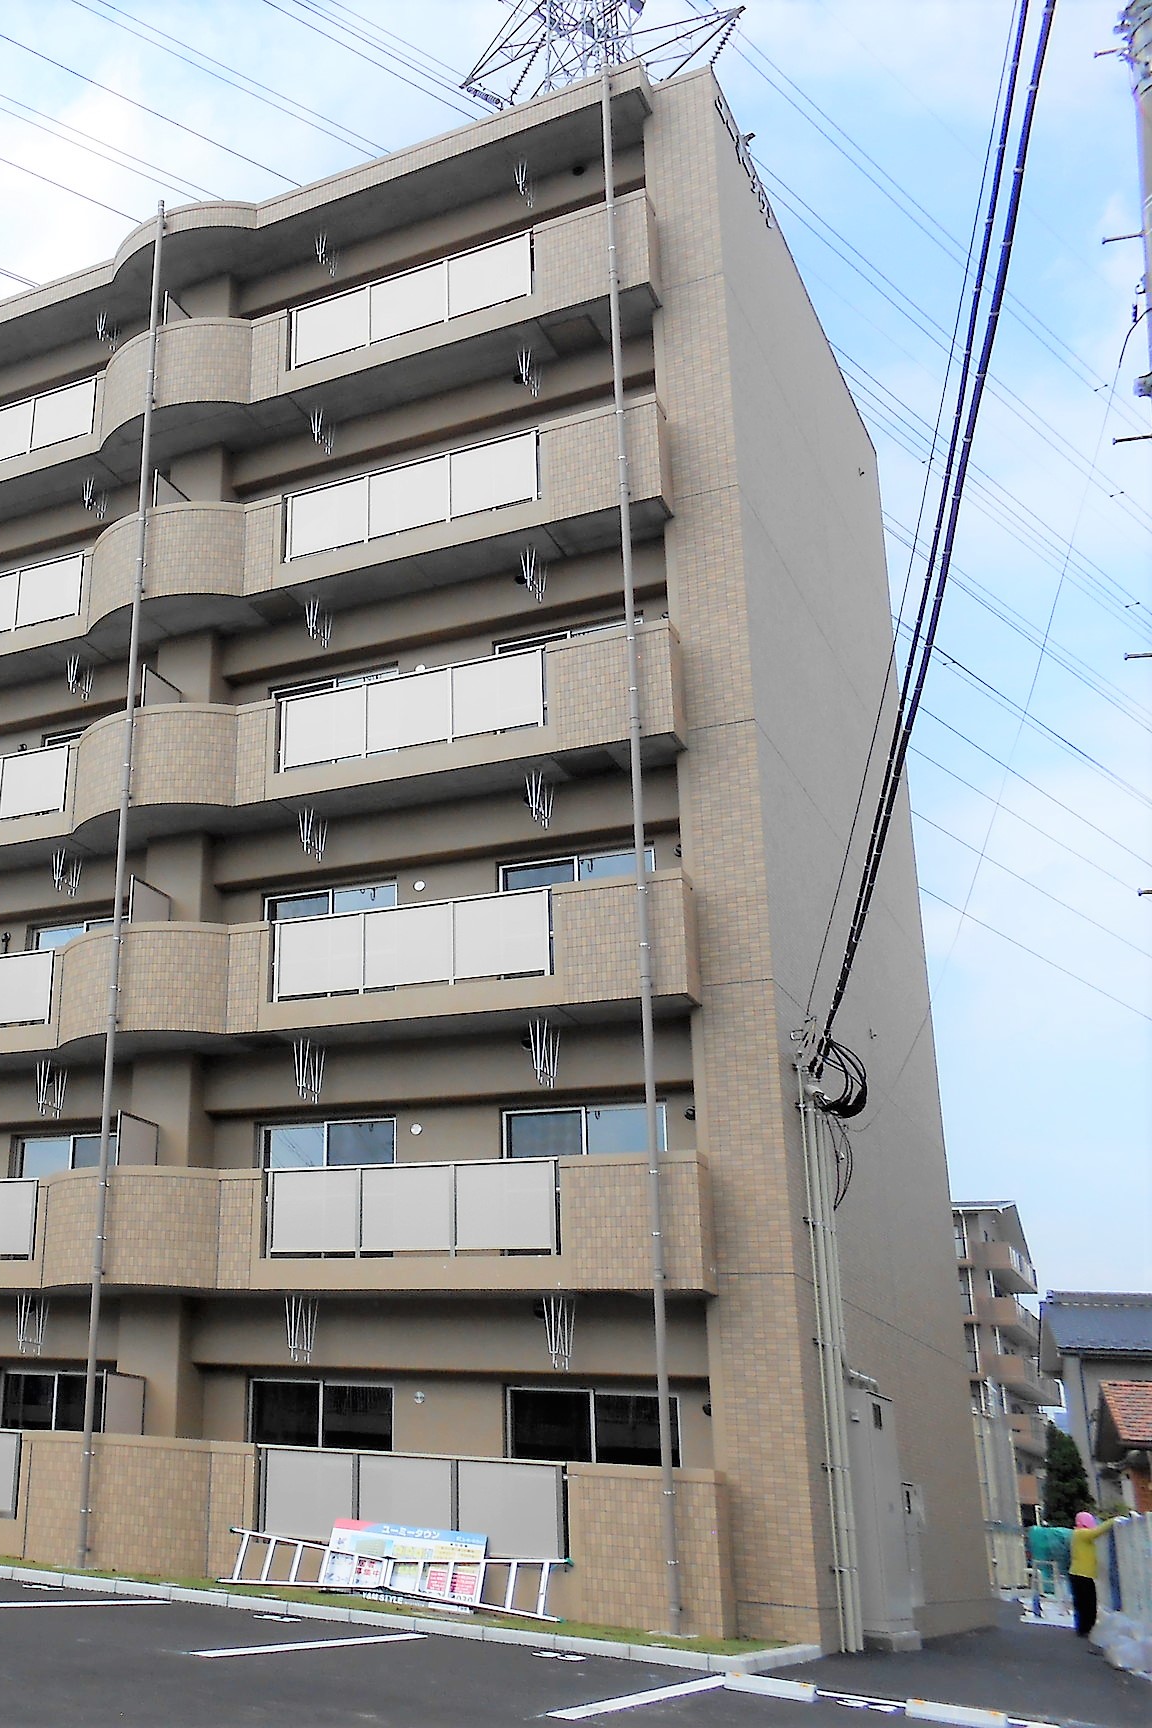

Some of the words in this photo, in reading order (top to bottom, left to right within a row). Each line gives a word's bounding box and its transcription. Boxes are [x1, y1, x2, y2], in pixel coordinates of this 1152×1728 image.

[381, 1525, 440, 1540] ユーミータウン
